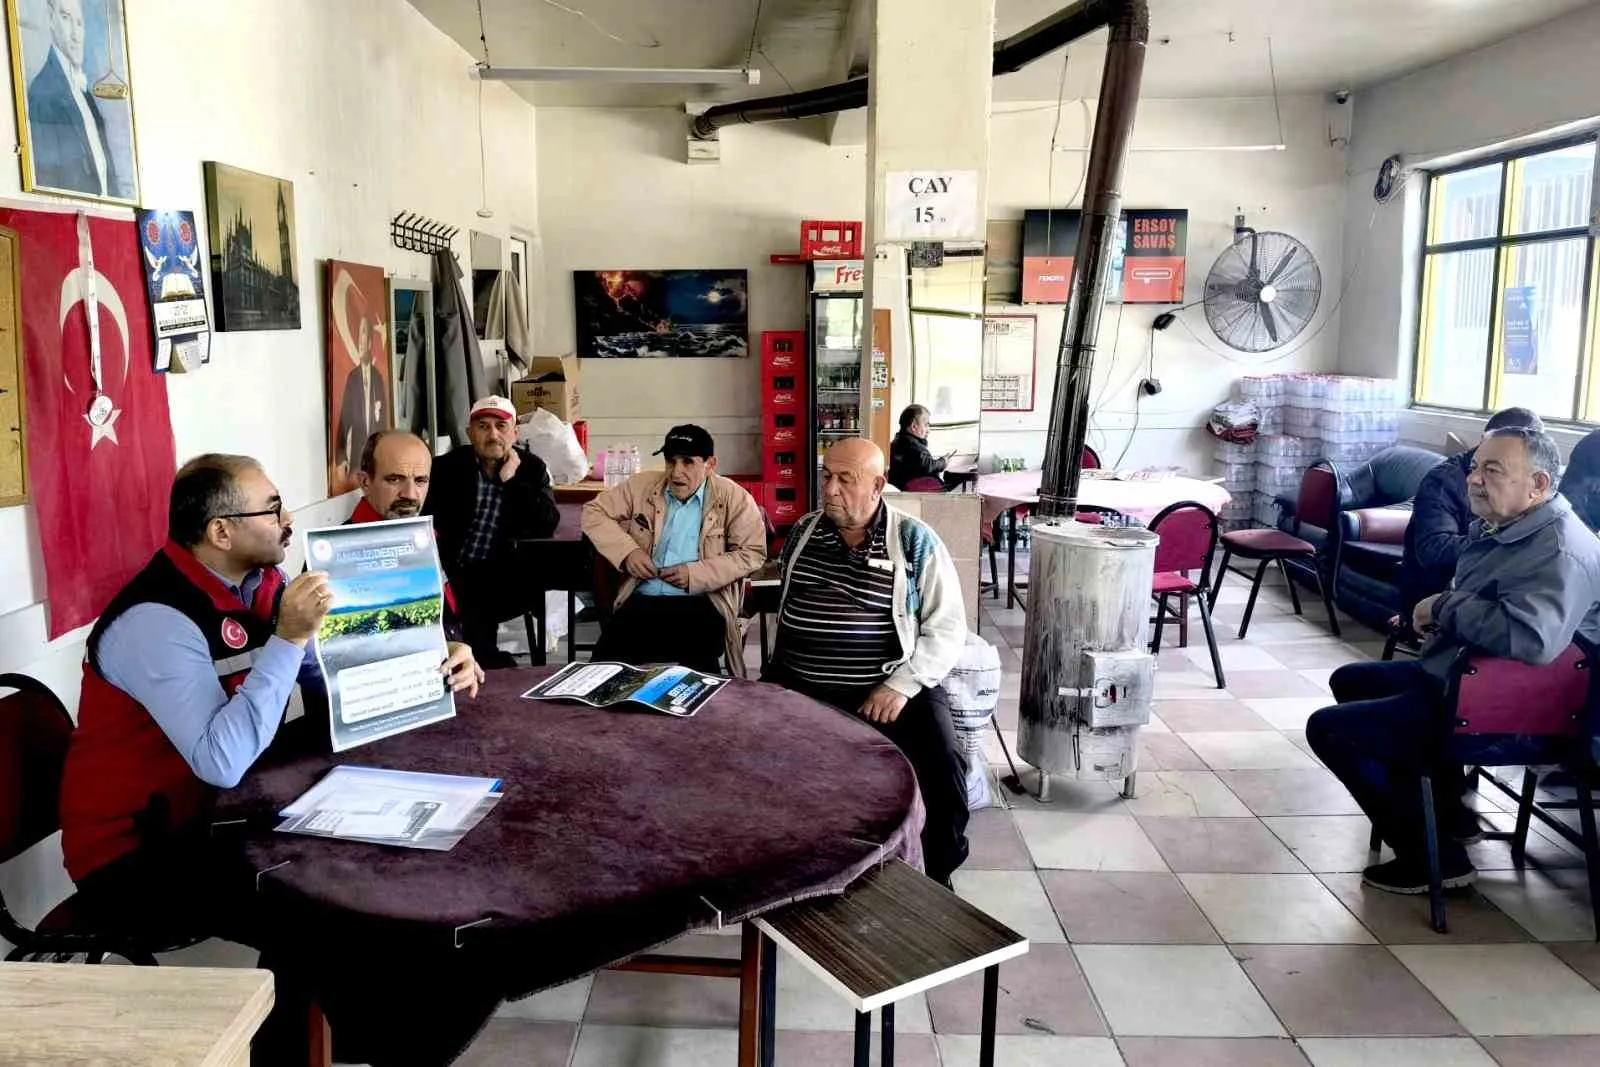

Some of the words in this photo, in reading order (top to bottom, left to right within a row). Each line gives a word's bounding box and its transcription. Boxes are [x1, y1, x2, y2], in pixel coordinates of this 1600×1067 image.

[908, 177, 952, 197] ÇAY
[914, 206, 935, 224] 15
[1134, 218, 1177, 233] ERSOY
[835, 265, 864, 285] Fre
